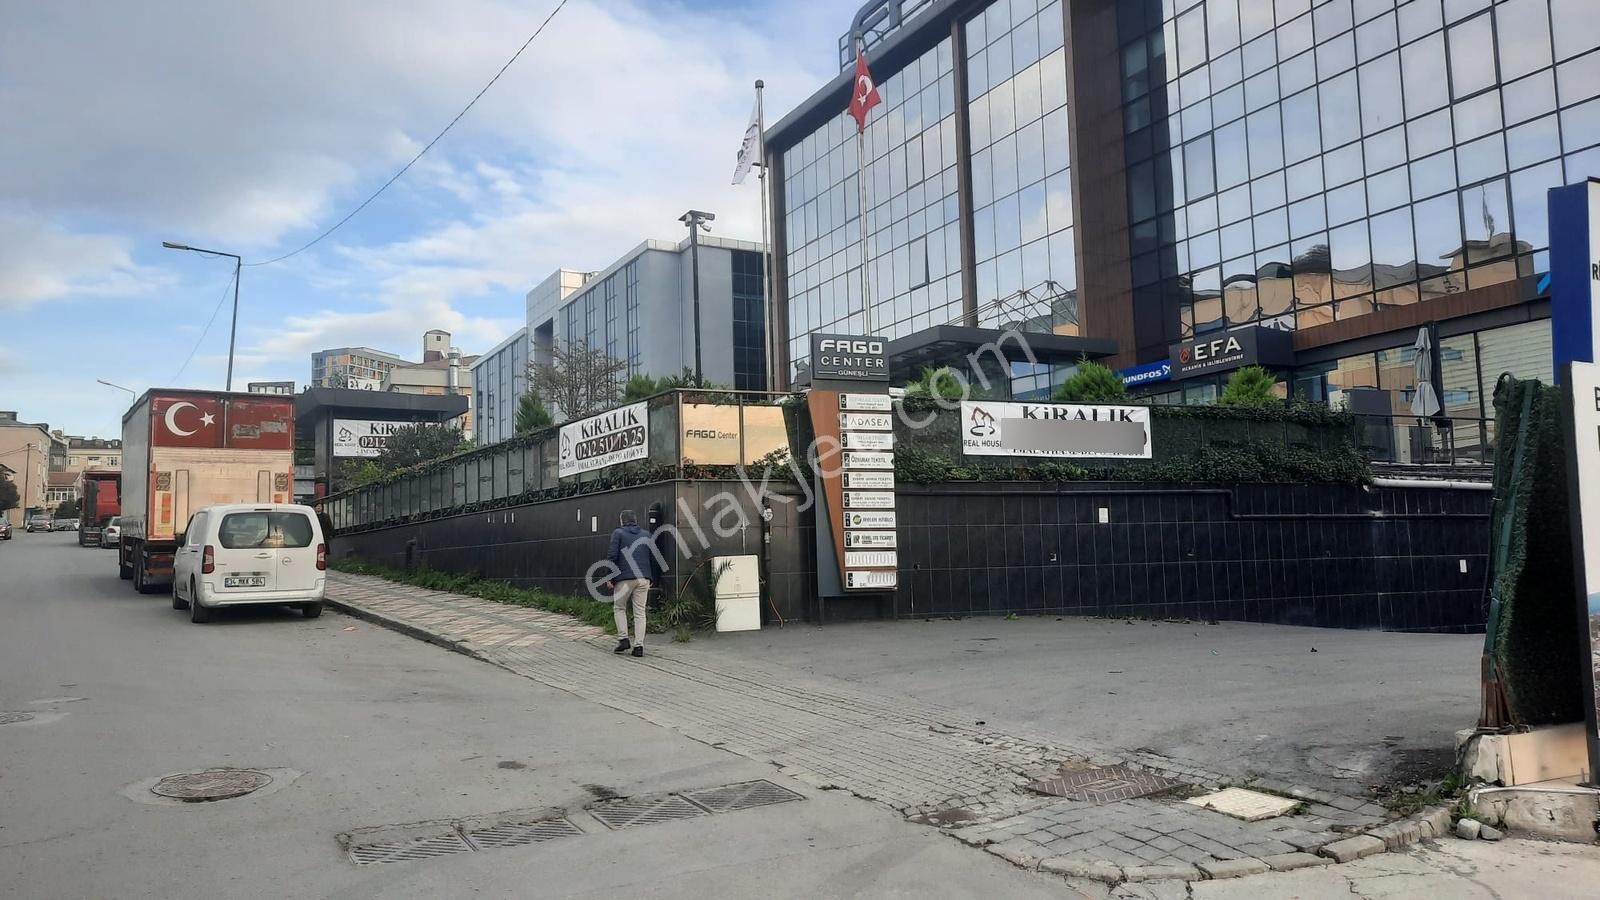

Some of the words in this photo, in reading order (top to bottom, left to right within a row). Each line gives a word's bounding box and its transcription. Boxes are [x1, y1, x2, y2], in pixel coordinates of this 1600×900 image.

[820, 339, 883, 354] FAGO
[1194, 336, 1242, 360] EFA
[820, 356, 884, 368] CENTER
[1122, 369, 1162, 384] UNDFOS
[850, 418, 890, 427] ADASEA
[686, 430, 716, 439] FAGO
[718, 431, 738, 439] Center
[576, 440, 597, 459] 0212
[631, 427, 643, 446] 25
